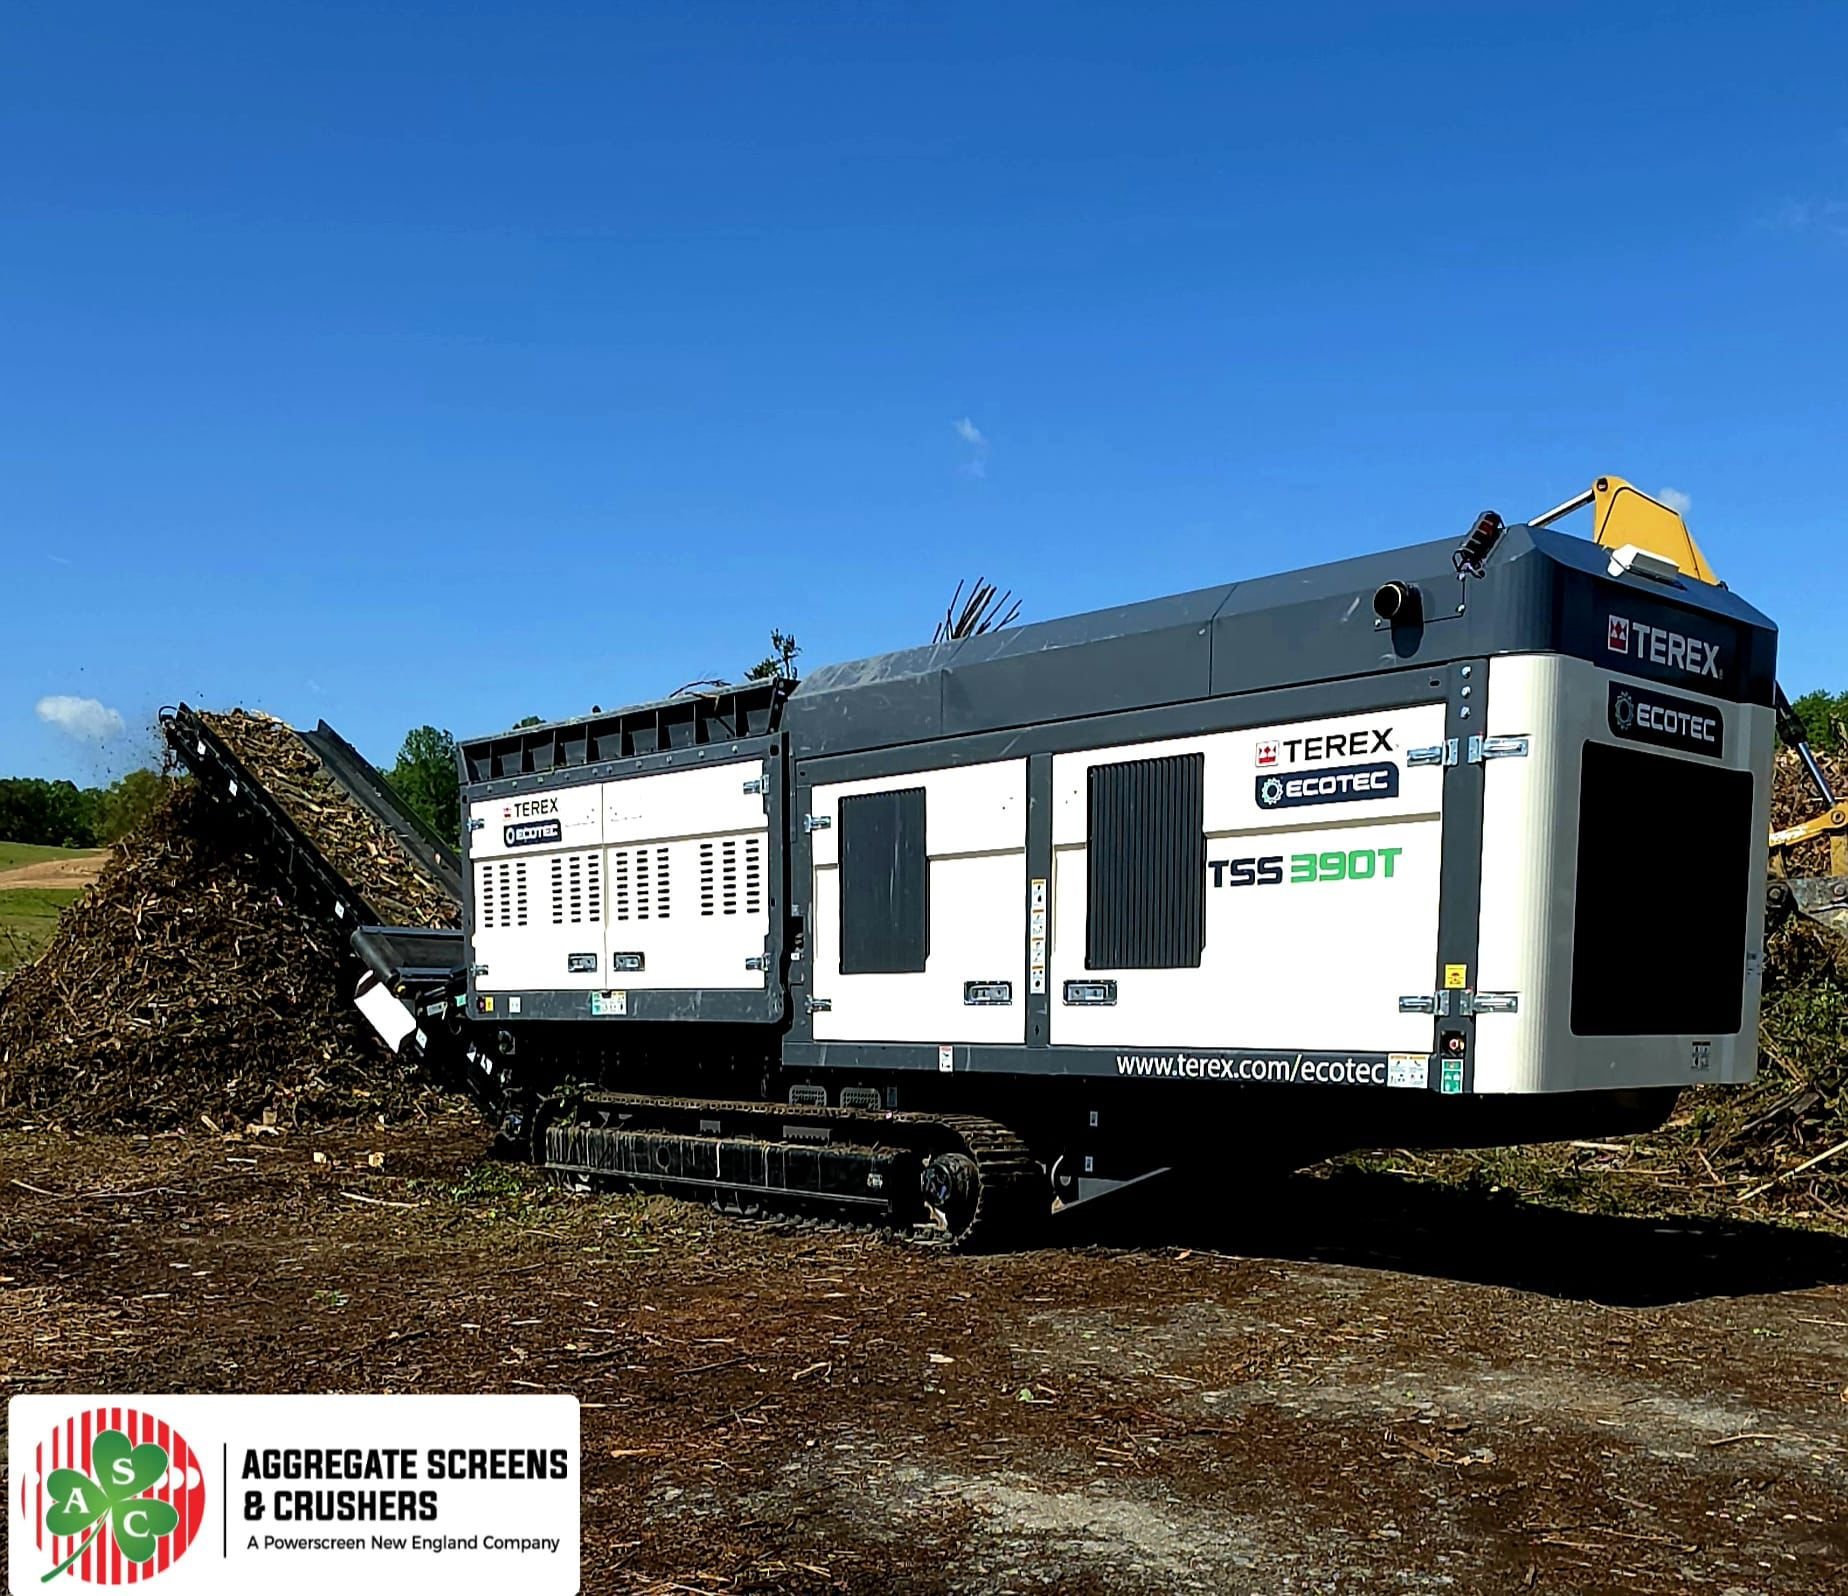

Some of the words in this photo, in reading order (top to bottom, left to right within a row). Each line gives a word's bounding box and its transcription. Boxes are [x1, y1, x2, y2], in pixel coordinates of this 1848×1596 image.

[1632, 621, 1719, 679] TEREX
[1637, 703, 1716, 742] ECOTEC
[1283, 727, 1394, 763] TEREX
[1286, 770, 1389, 798] ECOTEC
[514, 797, 559, 818] TEREX
[515, 823, 558, 841] ECOTEC
[1116, 1054, 1386, 1085] www.terex.com/ecotec
